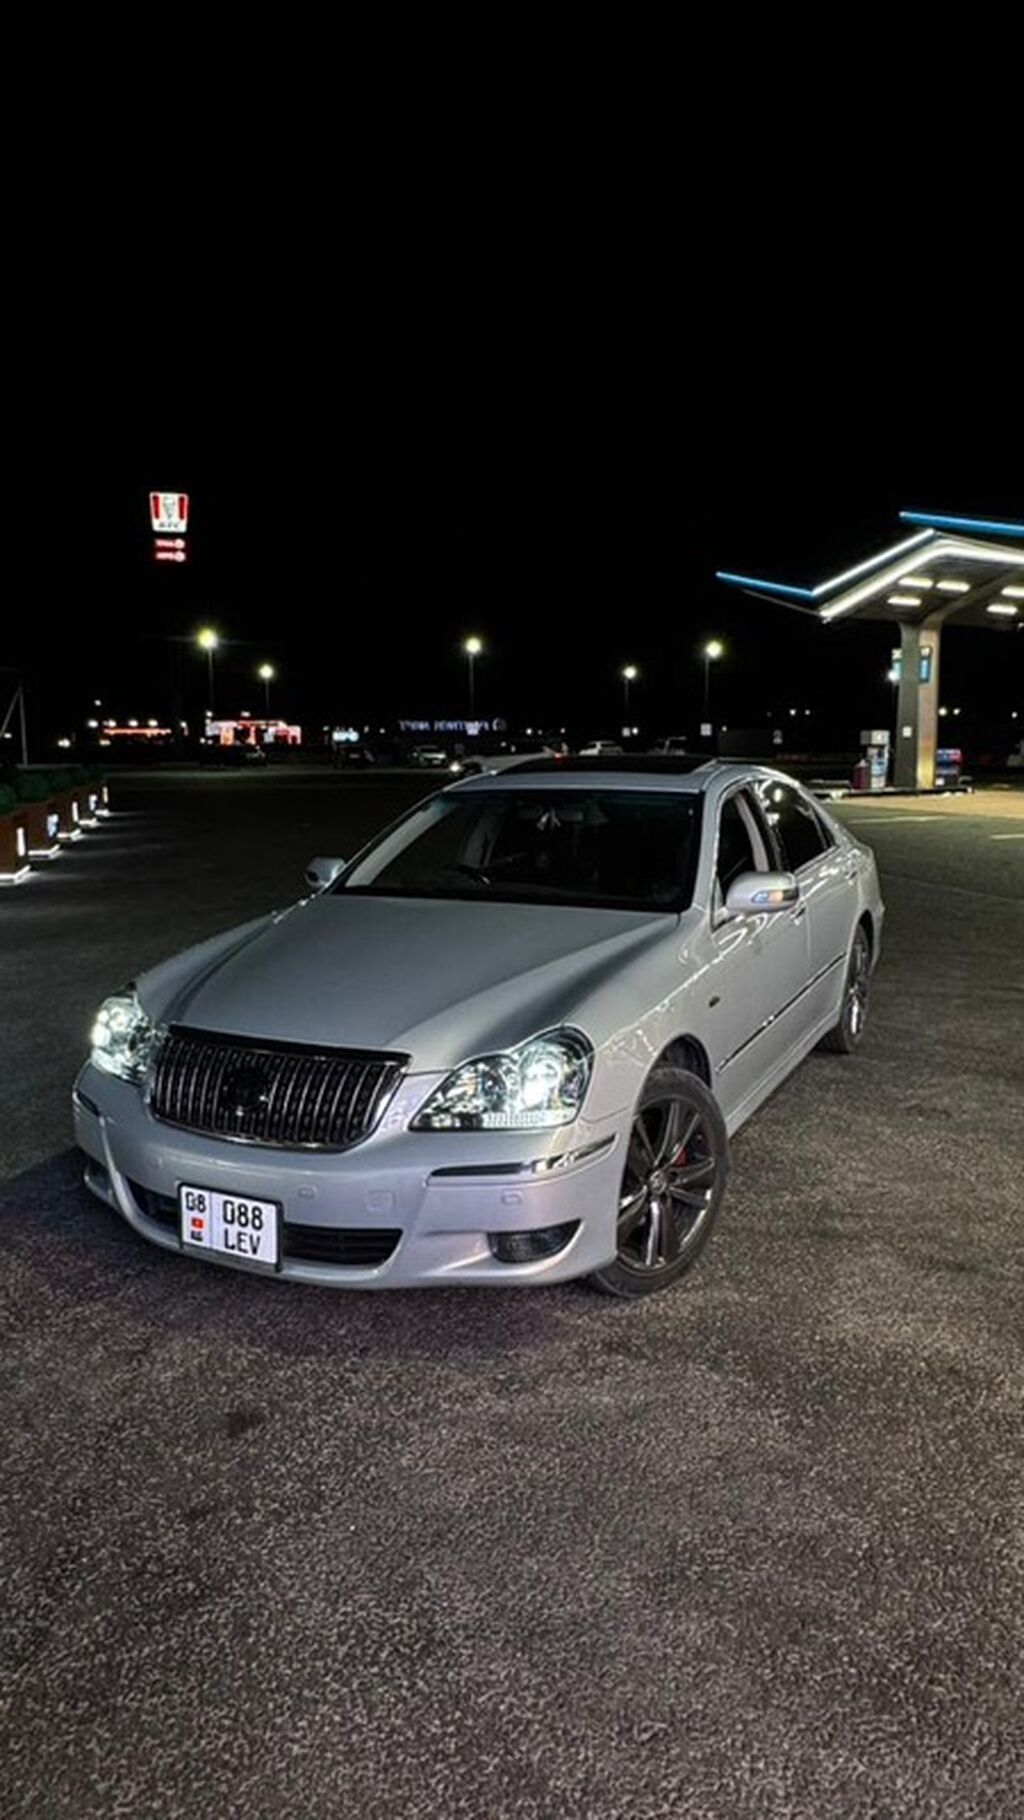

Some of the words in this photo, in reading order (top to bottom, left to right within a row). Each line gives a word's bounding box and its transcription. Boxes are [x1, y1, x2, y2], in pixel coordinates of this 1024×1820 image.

[185, 1191, 206, 1213] 08
[222, 1200, 263, 1231] 088
[224, 1228, 261, 1255] LEV
